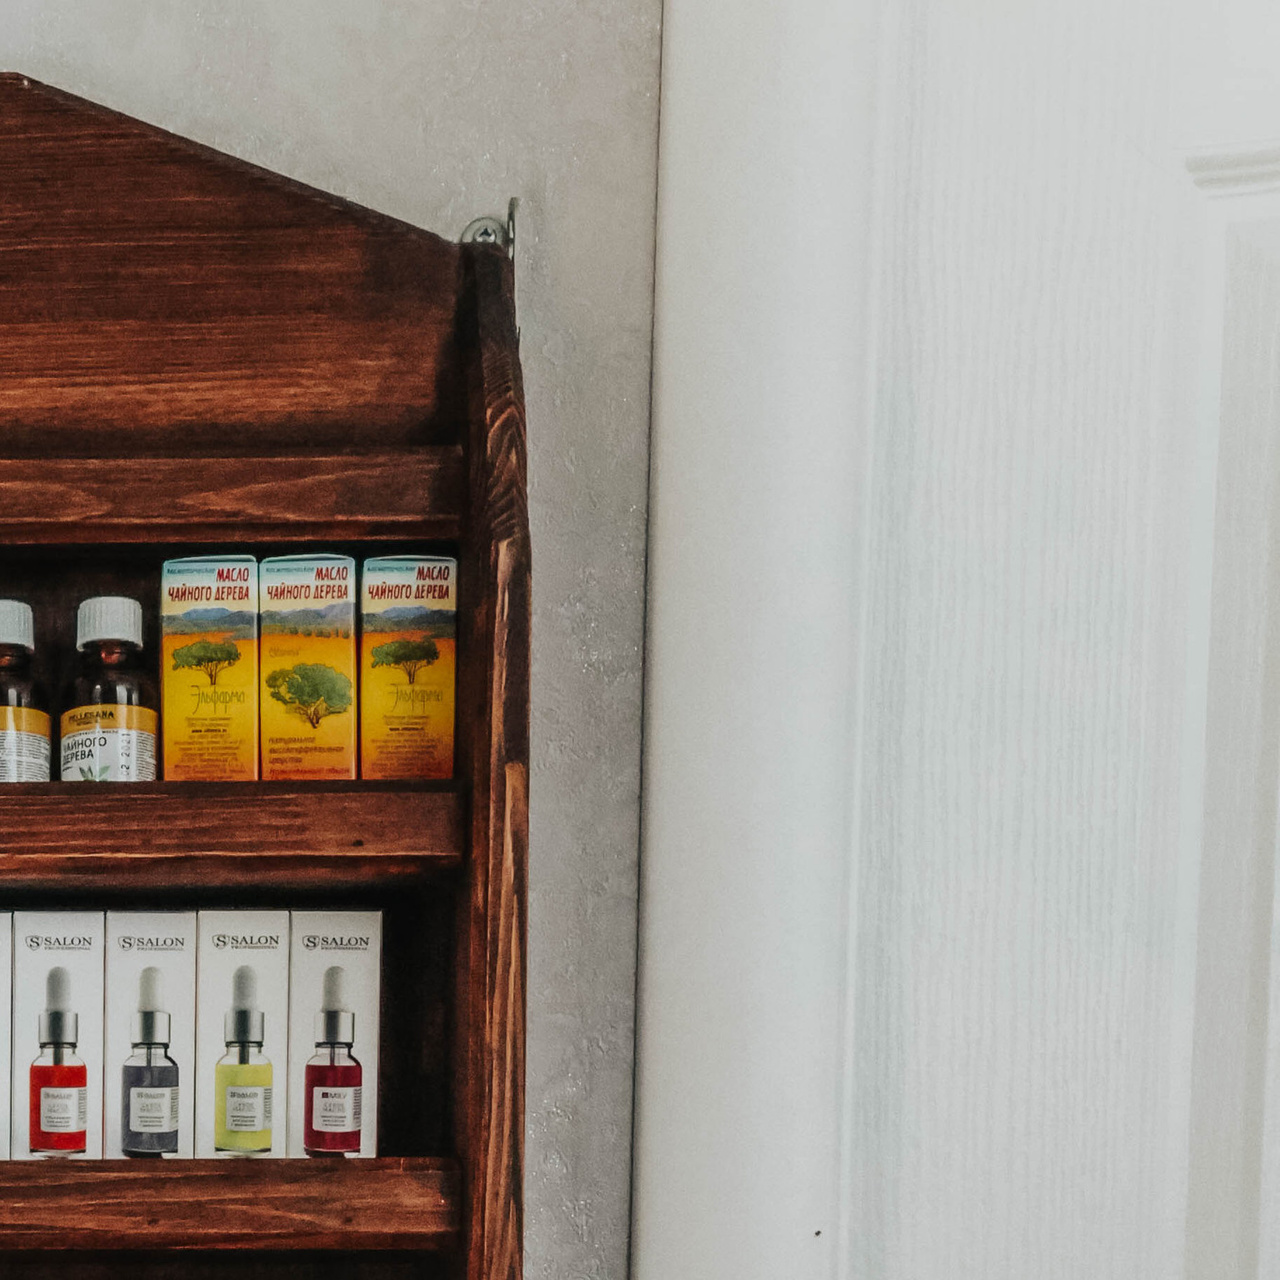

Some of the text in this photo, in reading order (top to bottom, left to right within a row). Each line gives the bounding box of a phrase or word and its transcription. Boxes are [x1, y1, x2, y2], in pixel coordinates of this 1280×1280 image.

[216, 568, 250, 582] МАСЛО
[315, 566, 348, 581] МАСЛО
[416, 566, 450, 580] МАСЛО
[168, 583, 249, 601] ЧАЙНОГО ДЕРЕВА
[267, 582, 348, 600] ЧАЙНОГО ДЕРЕВА
[368, 581, 449, 599] ЧАЙНОГО ДЕРЕВА
[44, 936, 92, 946] SALON
[137, 936, 185, 947] SALON
[231, 935, 279, 946] SALON
[321, 936, 369, 947] SALON
